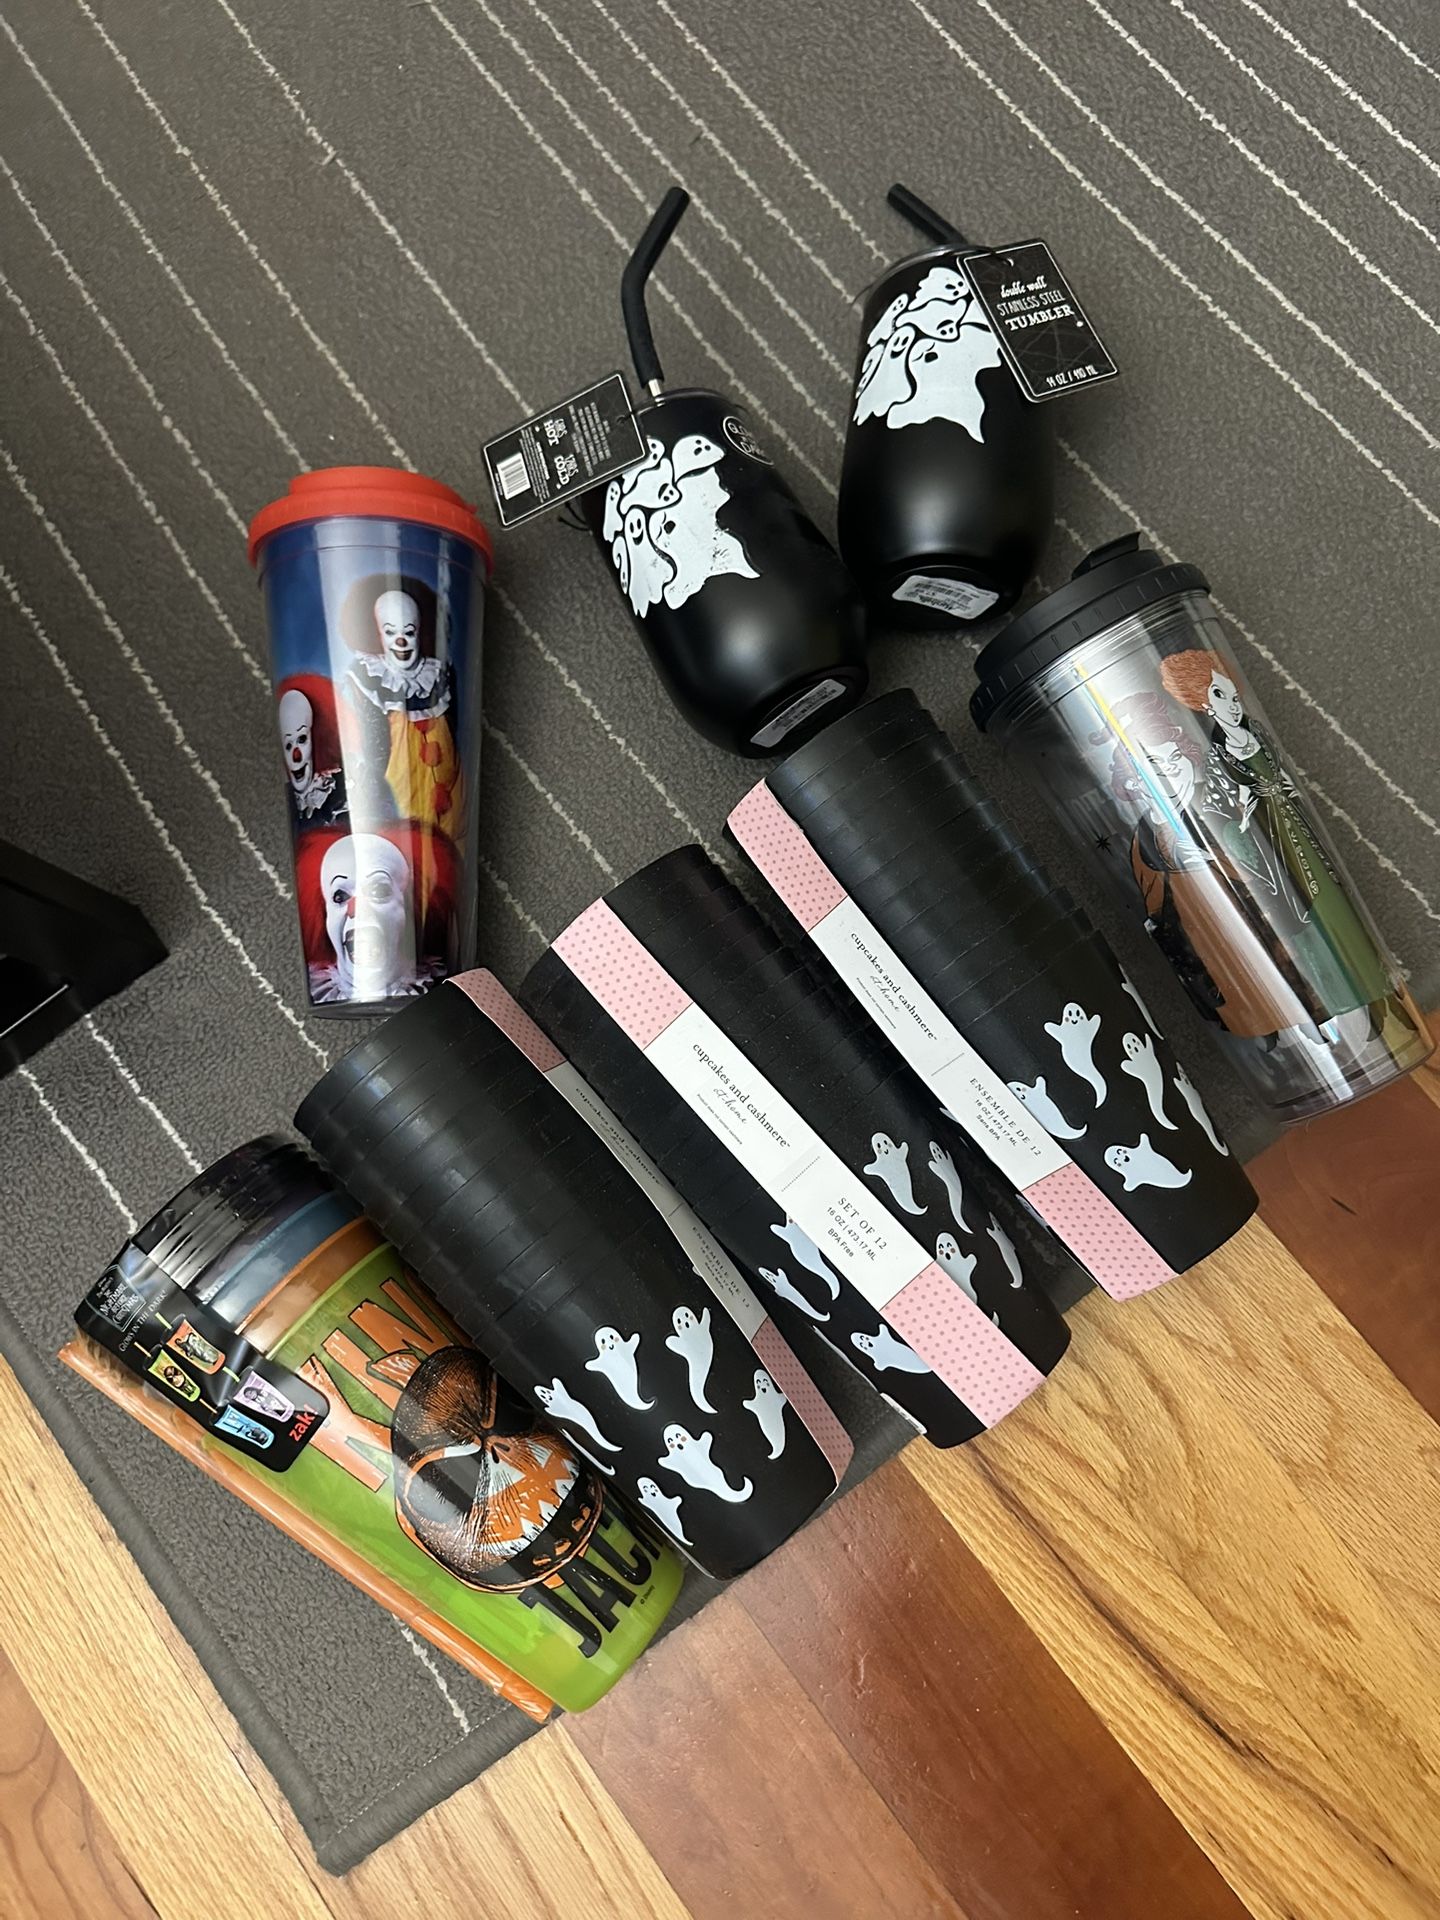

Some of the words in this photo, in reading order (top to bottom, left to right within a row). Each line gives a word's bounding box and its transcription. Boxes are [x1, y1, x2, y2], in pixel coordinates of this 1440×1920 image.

[997, 295, 1040, 317] STAINLESS
[1041, 290, 1066, 307] STEEL
[1001, 281, 1026, 299] double
[1026, 275, 1047, 293] wall
[1005, 304, 1075, 331] TUMBLER
[1055, 372, 1068, 385] OZ
[544, 420, 560, 446] HOT
[554, 455, 570, 485] COLD
[851, 933, 883, 974] cupcakes
[882, 974, 901, 994] and
[692, 1043, 730, 1085] cupcakes
[728, 1084, 750, 1104] and
[970, 1078, 1016, 1128] ENSEMBLE
[1016, 1129, 1030, 1144] DE
[1030, 1145, 1042, 1156] 12
[826, 1206, 836, 1216] 16
[834, 1215, 846, 1227] OZ
[847, 1229, 868, 1250] 473.17
[866, 1249, 877, 1261] ML
[828, 1228, 840, 1244] BPA
[840, 1241, 854, 1258] Free
[838, 1197, 860, 1218] SET
[859, 1219, 876, 1235] OF
[874, 1236, 887, 1250] 12
[118, 1332, 135, 1352] GLOWS
[132, 1324, 141, 1333] IN
[138, 1312, 150, 1325] THE
[148, 1290, 168, 1312] DARK!
[299, 1263, 477, 1494] KIN
[288, 1403, 319, 1442] zak!
